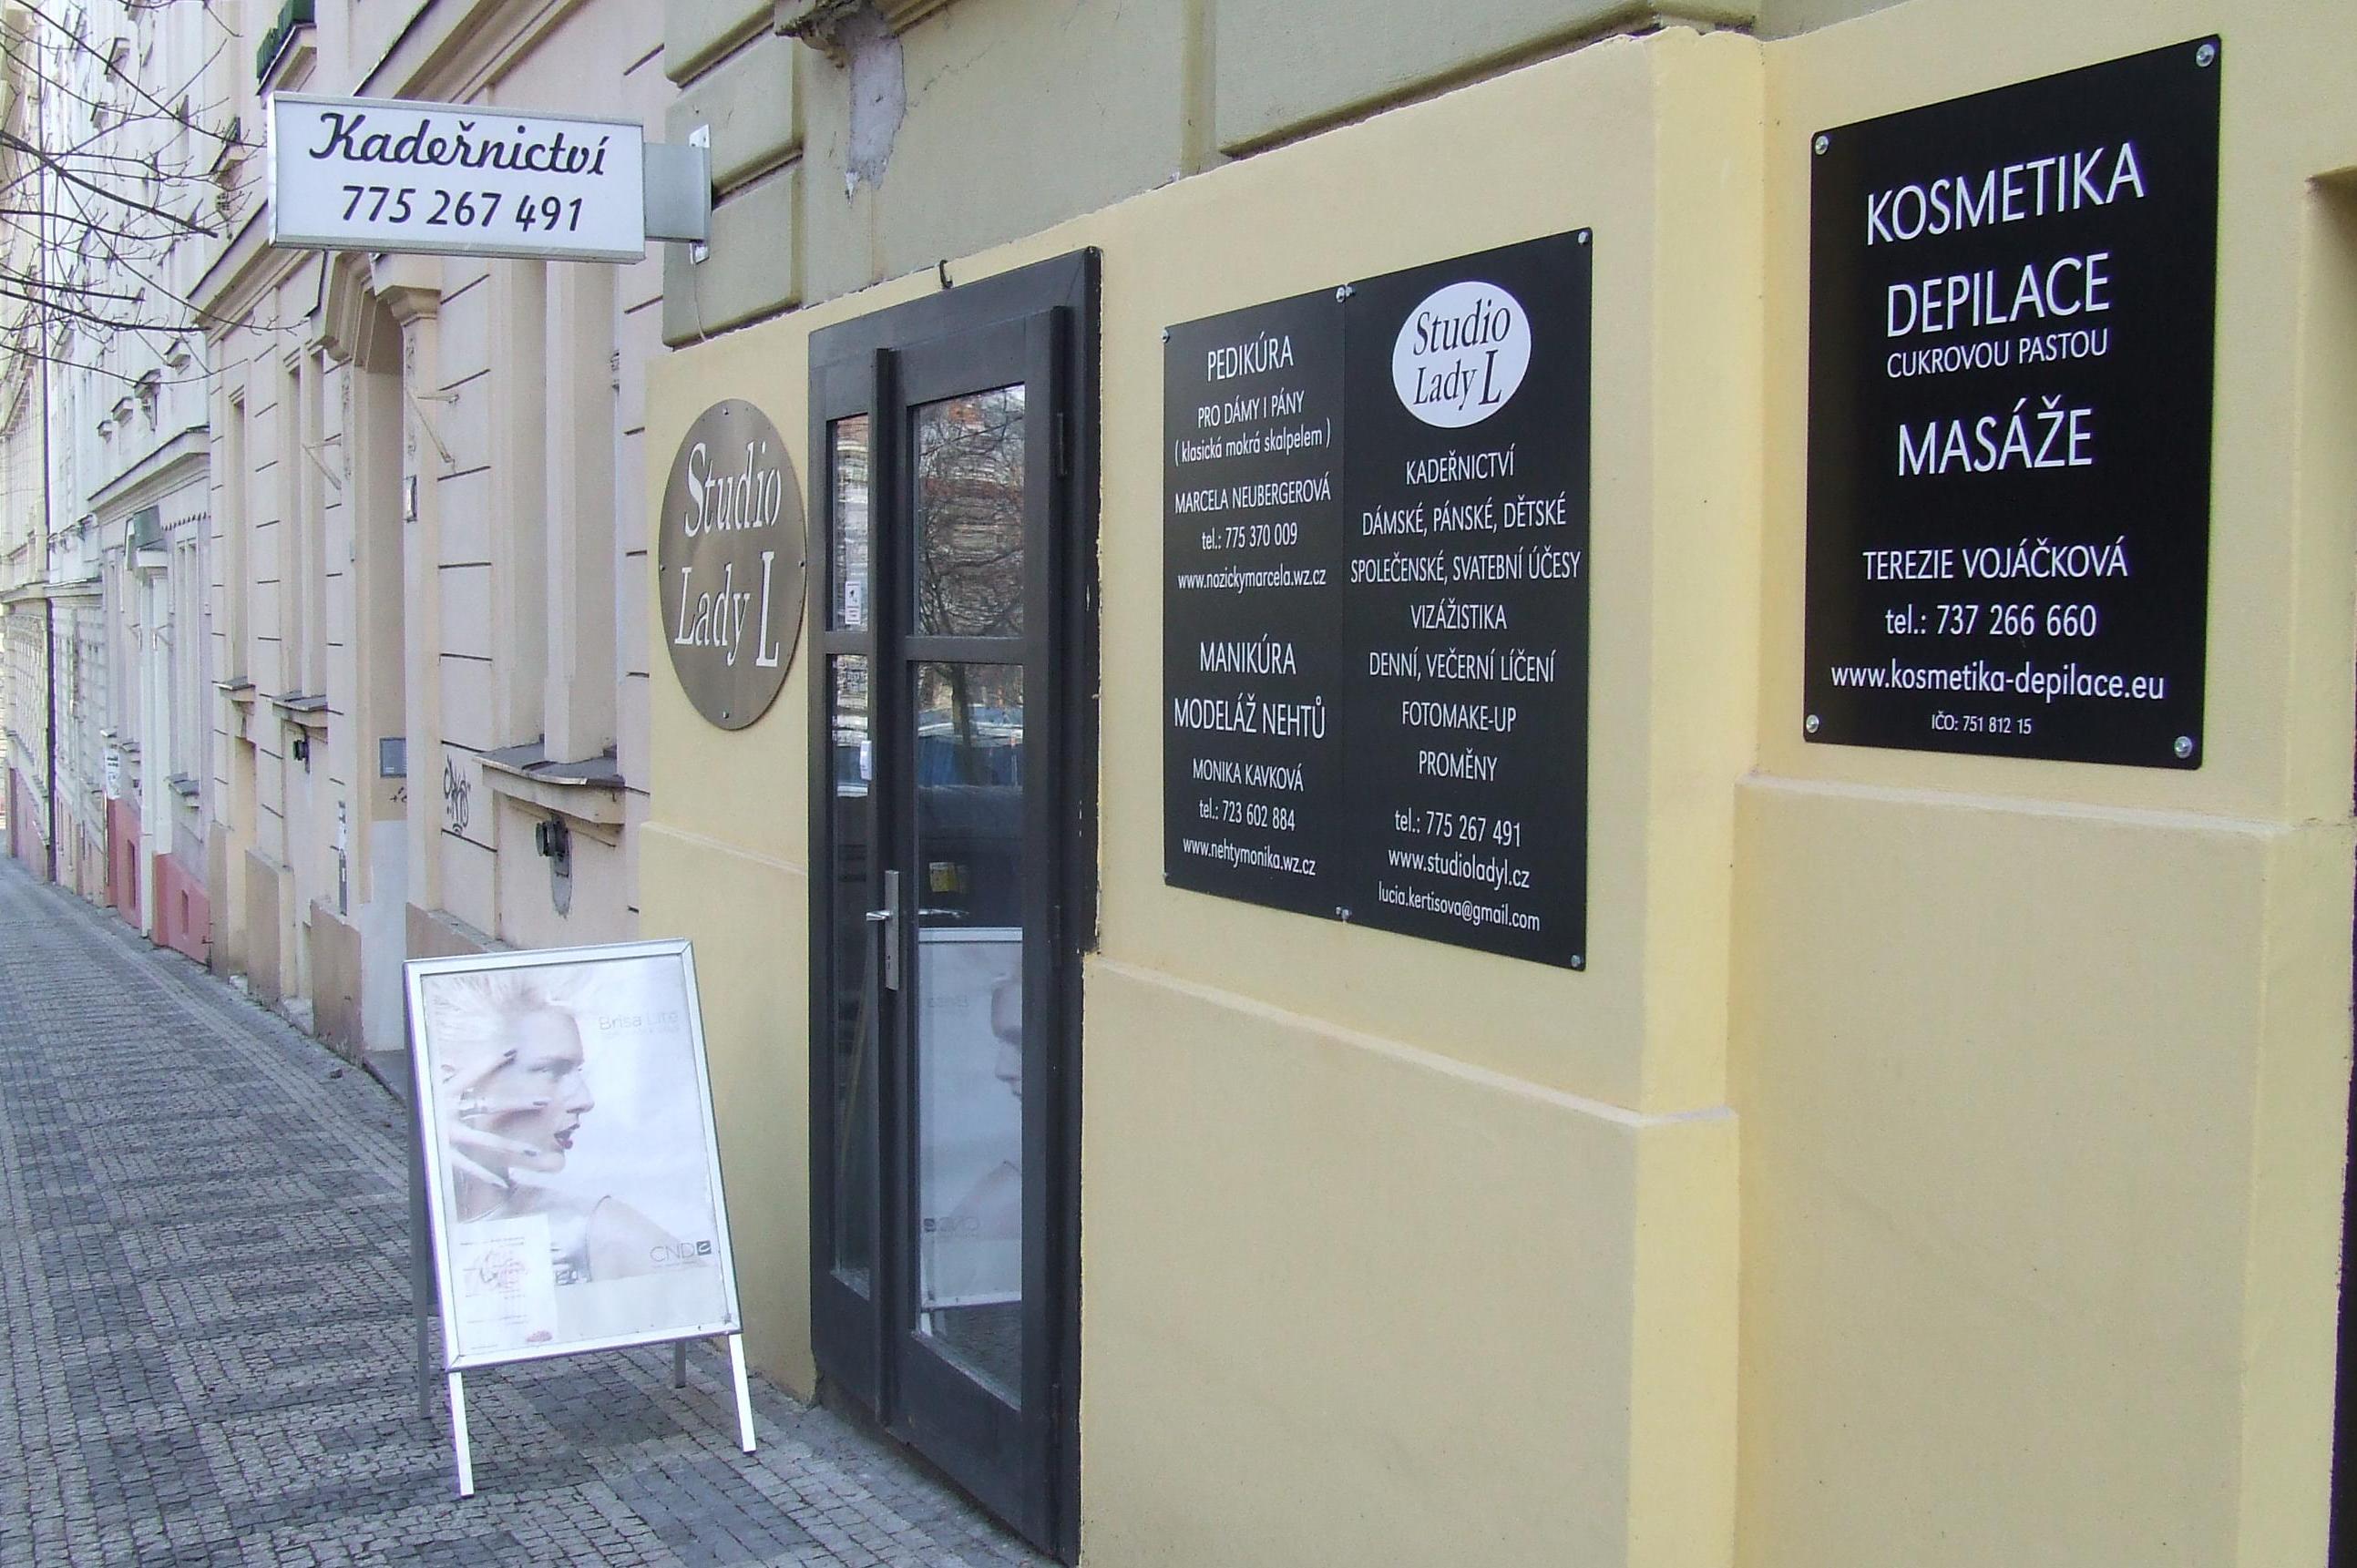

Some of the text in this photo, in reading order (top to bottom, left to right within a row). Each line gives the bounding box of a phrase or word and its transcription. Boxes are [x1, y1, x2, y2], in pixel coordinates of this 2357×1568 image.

[309, 112, 610, 176] Kadeřnictví
[343, 185, 583, 232] 775 267 491
[1867, 142, 2146, 246] KOSMETIKA
[1887, 252, 2110, 338] DEPILACE
[1413, 298, 1511, 356] Studio
[1207, 331, 1294, 382] PEDIKÚRA
[1887, 328, 2107, 378] CUKROVOU PASTOU
[1413, 349, 1502, 411] Lady L
[1197, 405, 1221, 429] PRO
[1225, 395, 1260, 425] DÁMY
[1271, 387, 1305, 417] PÁNY
[1225, 432, 1261, 457] mokrá
[1898, 394, 2093, 477] MASÁŽE
[1406, 443, 1515, 485] KADEŘNICTVÍ
[684, 440, 782, 538] Studio
[1175, 471, 1331, 515] MARCELA NEUBERGEROVÁ
[1202, 522, 1298, 550] tel.: 775 370 009
[1362, 491, 1566, 537] DÁMSKÉ, PÁNSKÉ, DĚTSKÉ
[1178, 562, 1327, 594] www.nozickymarcela.wz.cz
[1350, 545, 1581, 585] SPOLEČENSKÉ, SVATEBNÍ ÚČESY
[1862, 535, 2128, 581] TEREZIE VOJÁČKOVÁ
[674, 549, 780, 668] Lady L
[1410, 598, 1507, 630] VIZÁŽISTIKA
[1885, 604, 2097, 637] tel.: 737 266 660
[1200, 632, 1297, 675] MANIKÚRA
[1369, 647, 1556, 682] DENNÍ, VEČERNÍ LÍČENÍ
[1831, 658, 2165, 703] www.kosmetika-depilace.eu
[1174, 692, 1326, 739] MODELÁŽ NEHTŮ
[1402, 701, 1517, 733] FOTOMAKE-UP
[1932, 709, 2032, 734] IČO: 751 812 15
[1193, 757, 1304, 792] MONIKA KAVKOVÁ
[1419, 747, 1497, 782] PROMĚNY
[1199, 797, 1296, 832] tel.: 723 602 884
[1395, 808, 1522, 847] tel.: 775 267 491
[1183, 836, 1317, 876] www.nehtymonika.wz.cz
[1388, 847, 1531, 891] www.studioladyl.cz
[1378, 880, 1541, 932] lucia.kertisova@gmail.com
